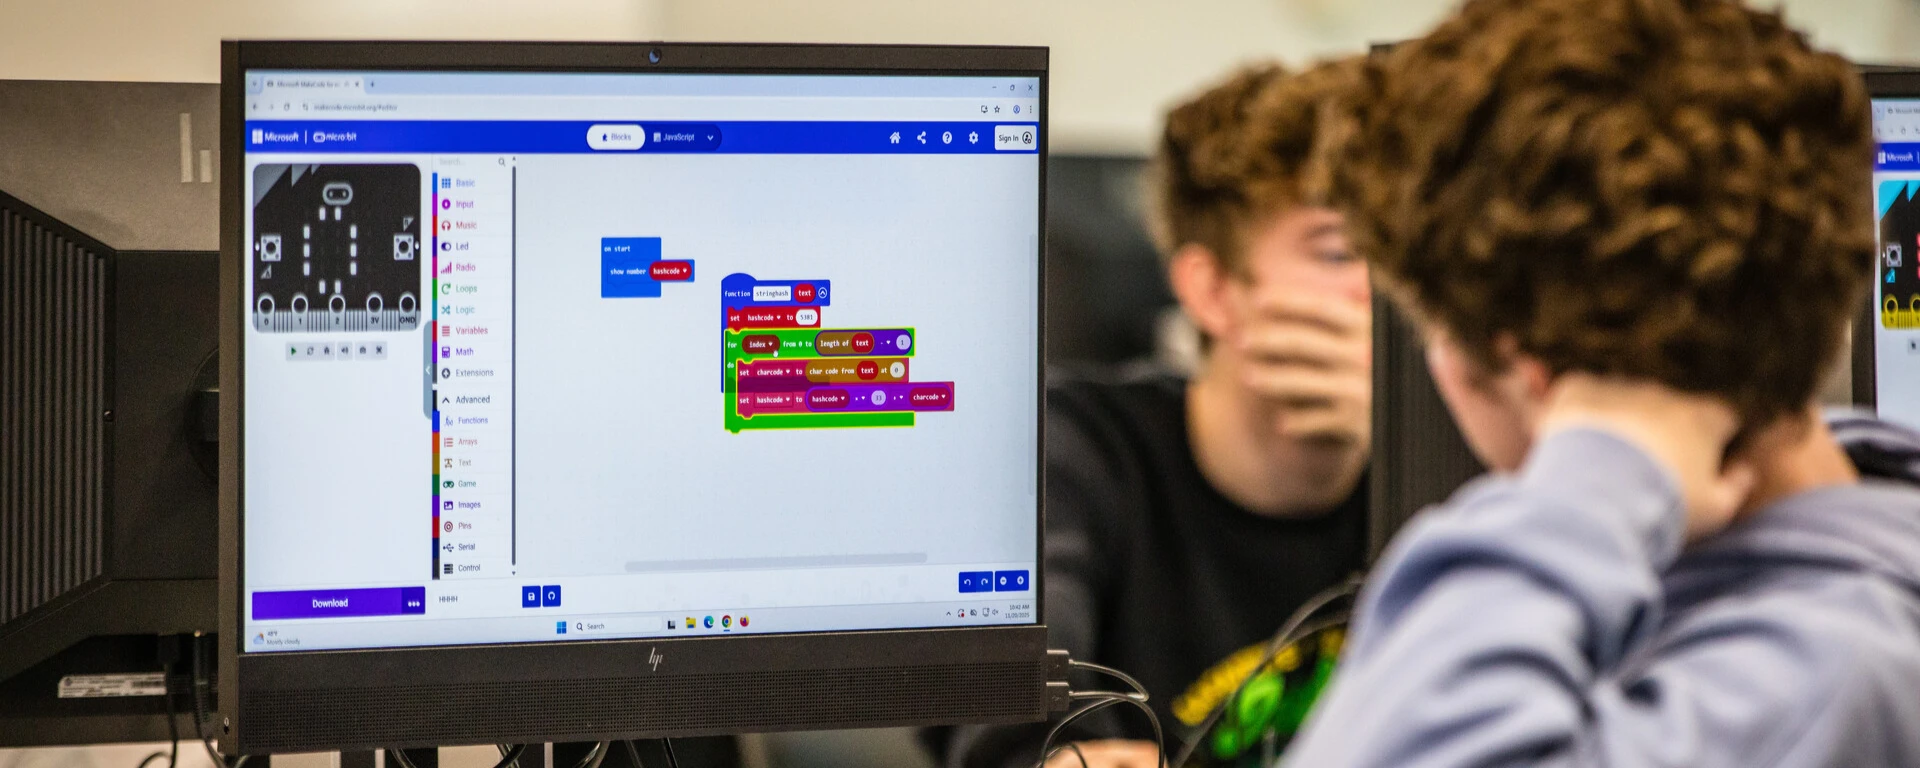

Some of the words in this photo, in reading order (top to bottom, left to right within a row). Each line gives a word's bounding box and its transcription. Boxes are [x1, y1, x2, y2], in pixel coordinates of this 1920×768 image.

[264, 132, 299, 142] Microsoft
[326, 132, 356, 140] micro:bit
[663, 133, 694, 142] JavaScript
[998, 135, 1011, 144] Sign
[1887, 152, 1914, 162] Microsoft
[456, 179, 475, 188] Basic
[456, 200, 474, 210] Input
[456, 221, 477, 229] Music
[456, 242, 469, 250] Led
[456, 263, 476, 272] Radio
[456, 284, 478, 294] Loops
[756, 290, 788, 298] stringhash
[456, 306, 475, 314] Logic
[456, 326, 488, 334] Variables
[820, 340, 840, 348] length
[456, 348, 474, 356] Math
[456, 369, 494, 377] Extensions
[456, 395, 490, 404] Advanced
[458, 416, 488, 424] Functions
[458, 438, 478, 446] Arrays
[458, 458, 472, 466] Text
[458, 501, 481, 510] Images
[458, 543, 476, 551] Serial
[458, 564, 480, 572] Control
[312, 598, 348, 608] Download
[586, 622, 604, 630] Search
